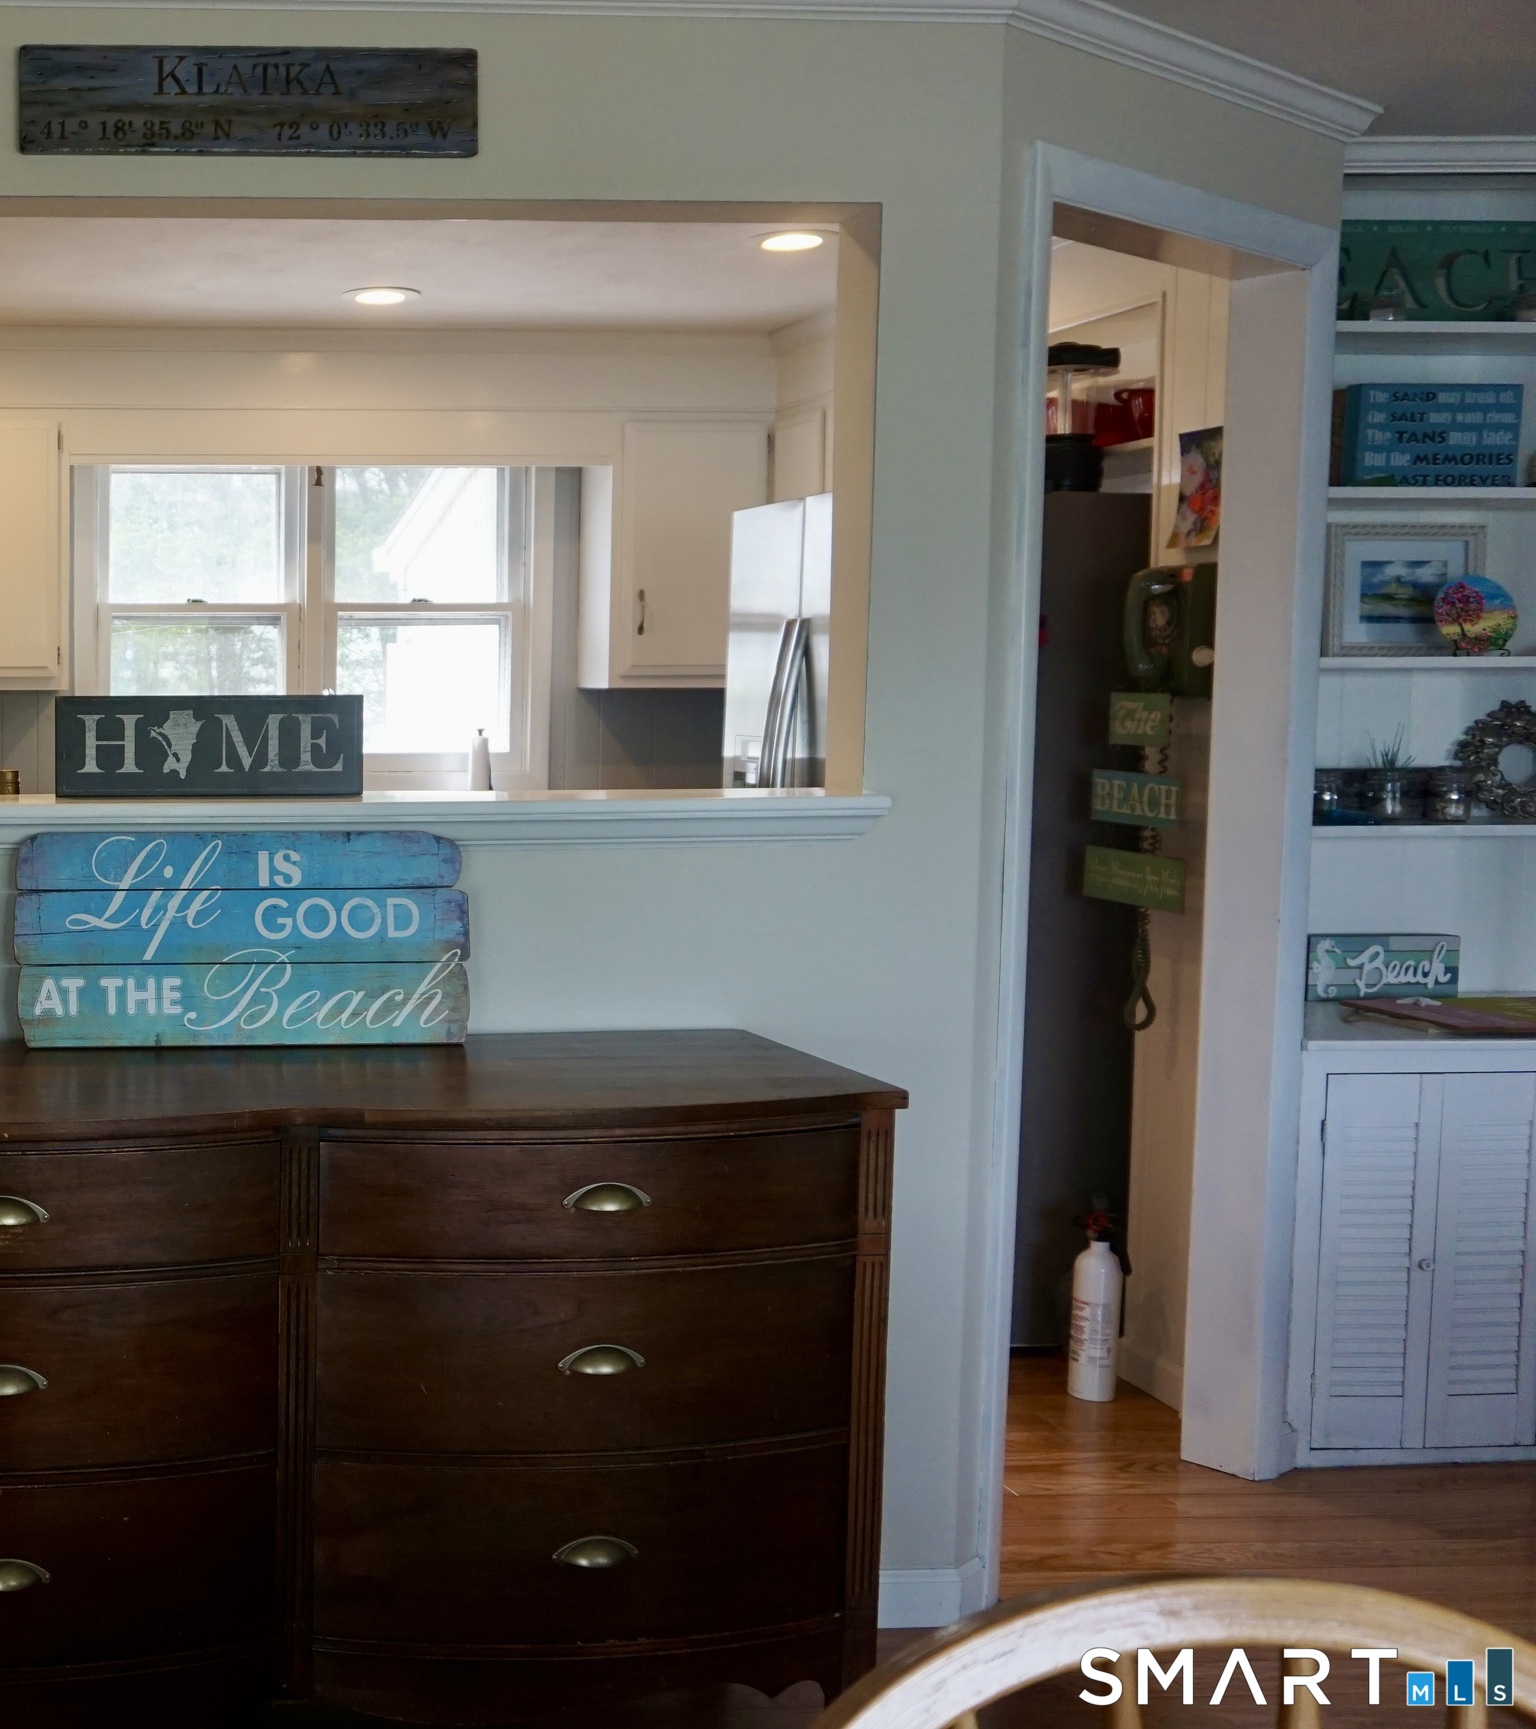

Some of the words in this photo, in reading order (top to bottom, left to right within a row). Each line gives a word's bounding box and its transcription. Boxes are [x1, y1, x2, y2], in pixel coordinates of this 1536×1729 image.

[152, 55, 345, 97] KLATKA
[212, 117, 234, 141] N
[427, 119, 452, 141] W
[1392, 390, 1437, 403] SAND
[1390, 411, 1427, 423] SALT
[1395, 430, 1447, 445] TANS
[1412, 452, 1514, 466] MEMORIES
[1392, 473, 1430, 486] AST
[1114, 699, 1162, 737] The
[1095, 777, 1180, 821] BEACH
[65, 836, 223, 961] Life
[257, 849, 303, 889] IS
[254, 897, 421, 940] GOOD
[1345, 941, 1452, 998] Beach
[33, 975, 86, 1018] AT
[99, 975, 184, 1018] THE
[183, 948, 462, 1032] Beach
